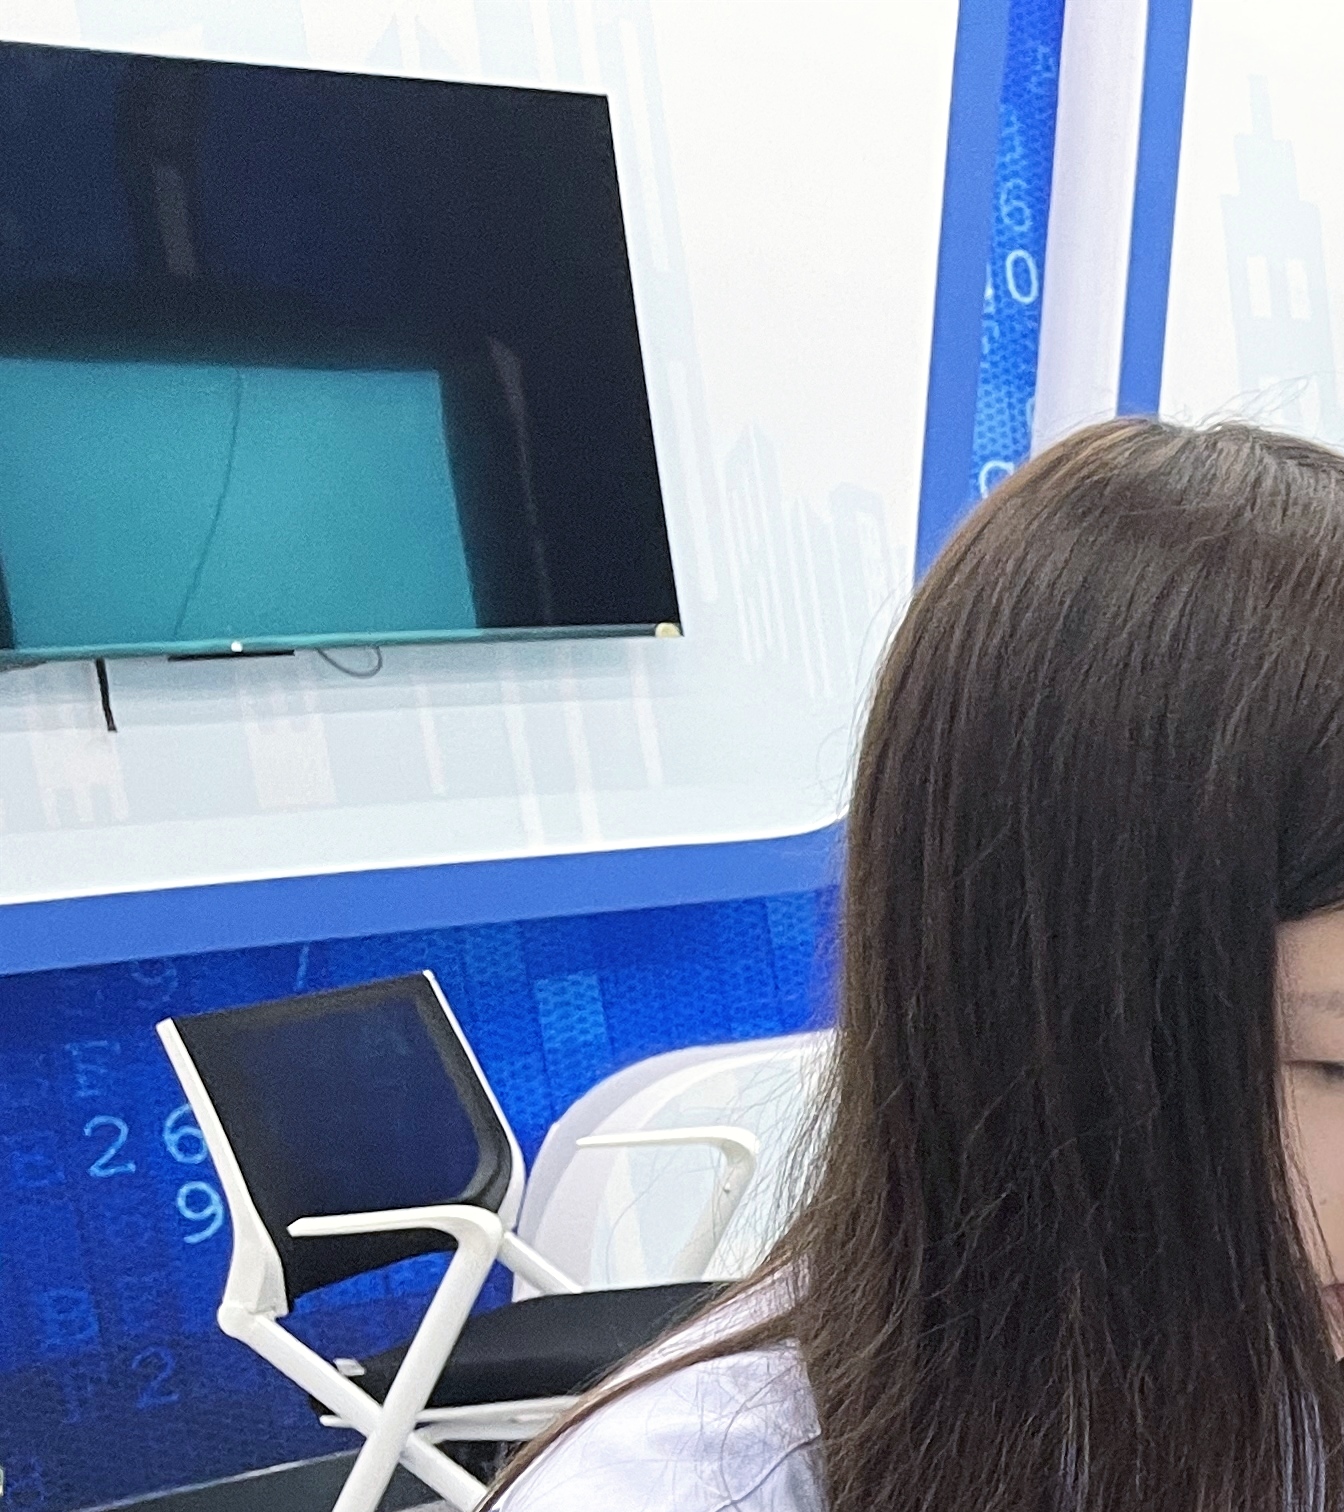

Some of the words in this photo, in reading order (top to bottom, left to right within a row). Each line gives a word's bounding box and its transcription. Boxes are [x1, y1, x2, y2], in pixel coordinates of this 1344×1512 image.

[83, 1114, 136, 1177] 2
[163, 1103, 207, 1165] 6
[176, 1181, 224, 1244] 9
